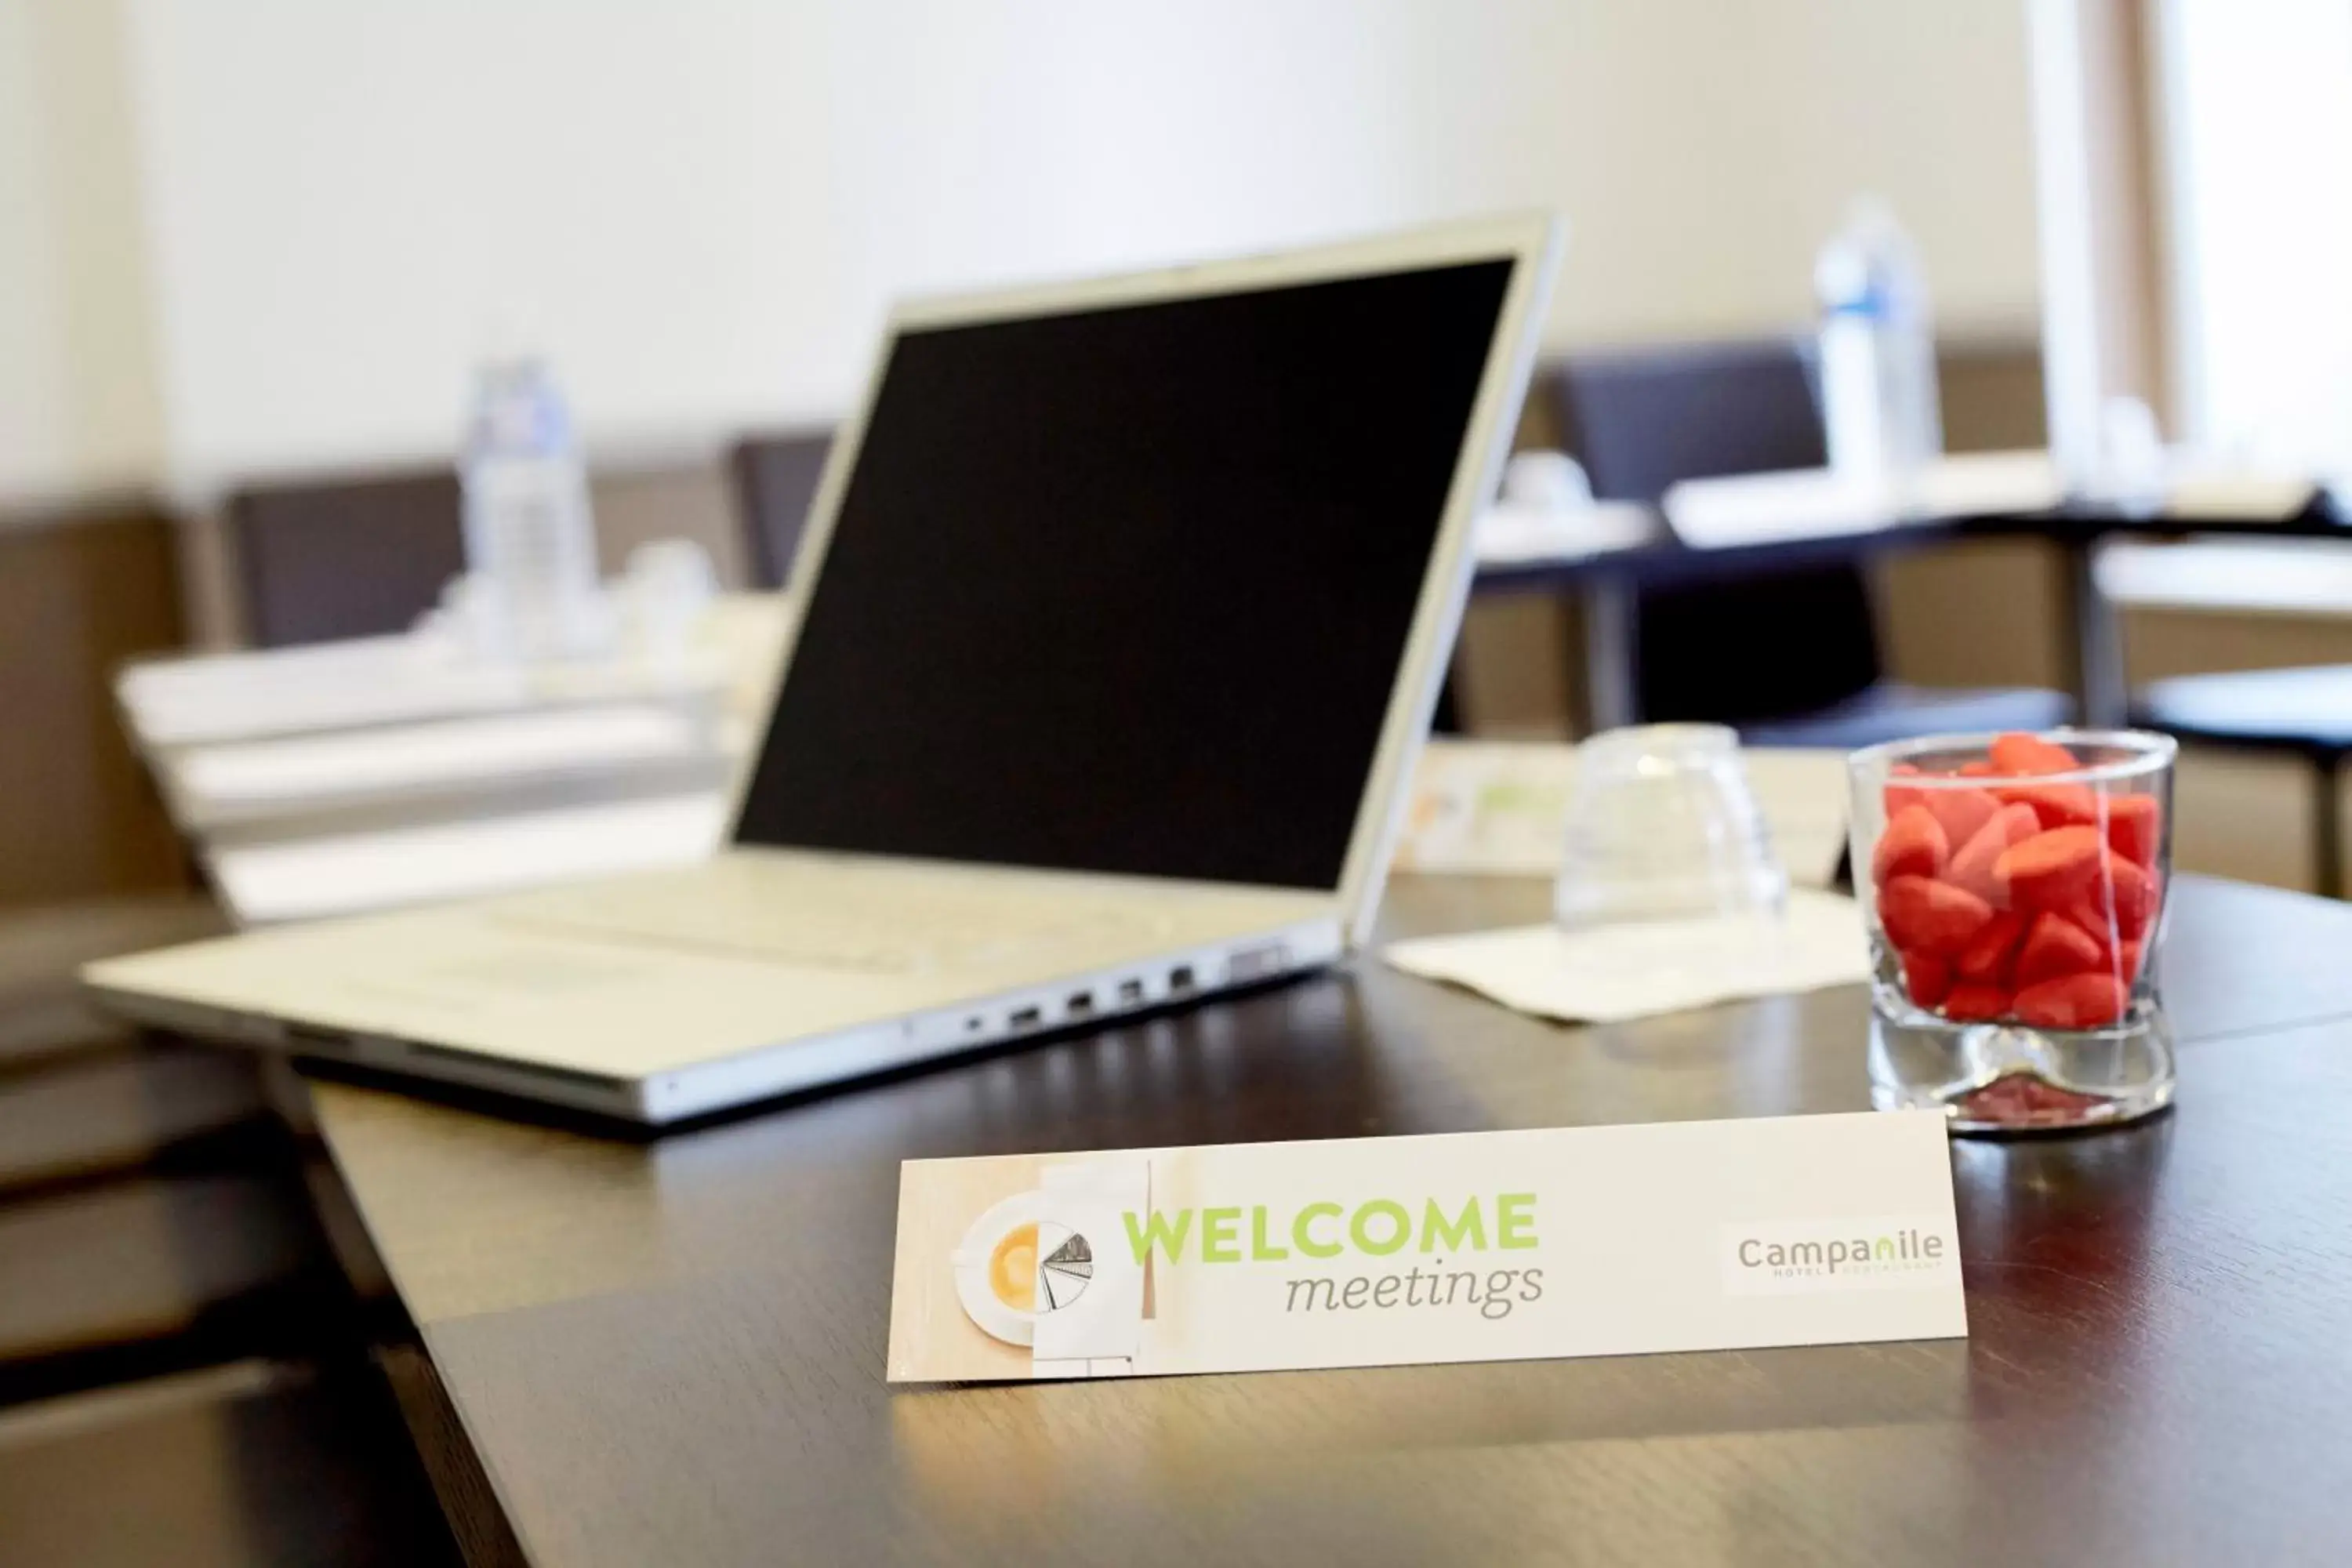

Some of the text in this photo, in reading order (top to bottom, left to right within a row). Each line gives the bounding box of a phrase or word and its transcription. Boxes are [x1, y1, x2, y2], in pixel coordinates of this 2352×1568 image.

[1123, 1192, 1538, 1265] WELCOME
[1739, 1229, 1943, 1274] Campanile
[1287, 1258, 1543, 1319] meetings
